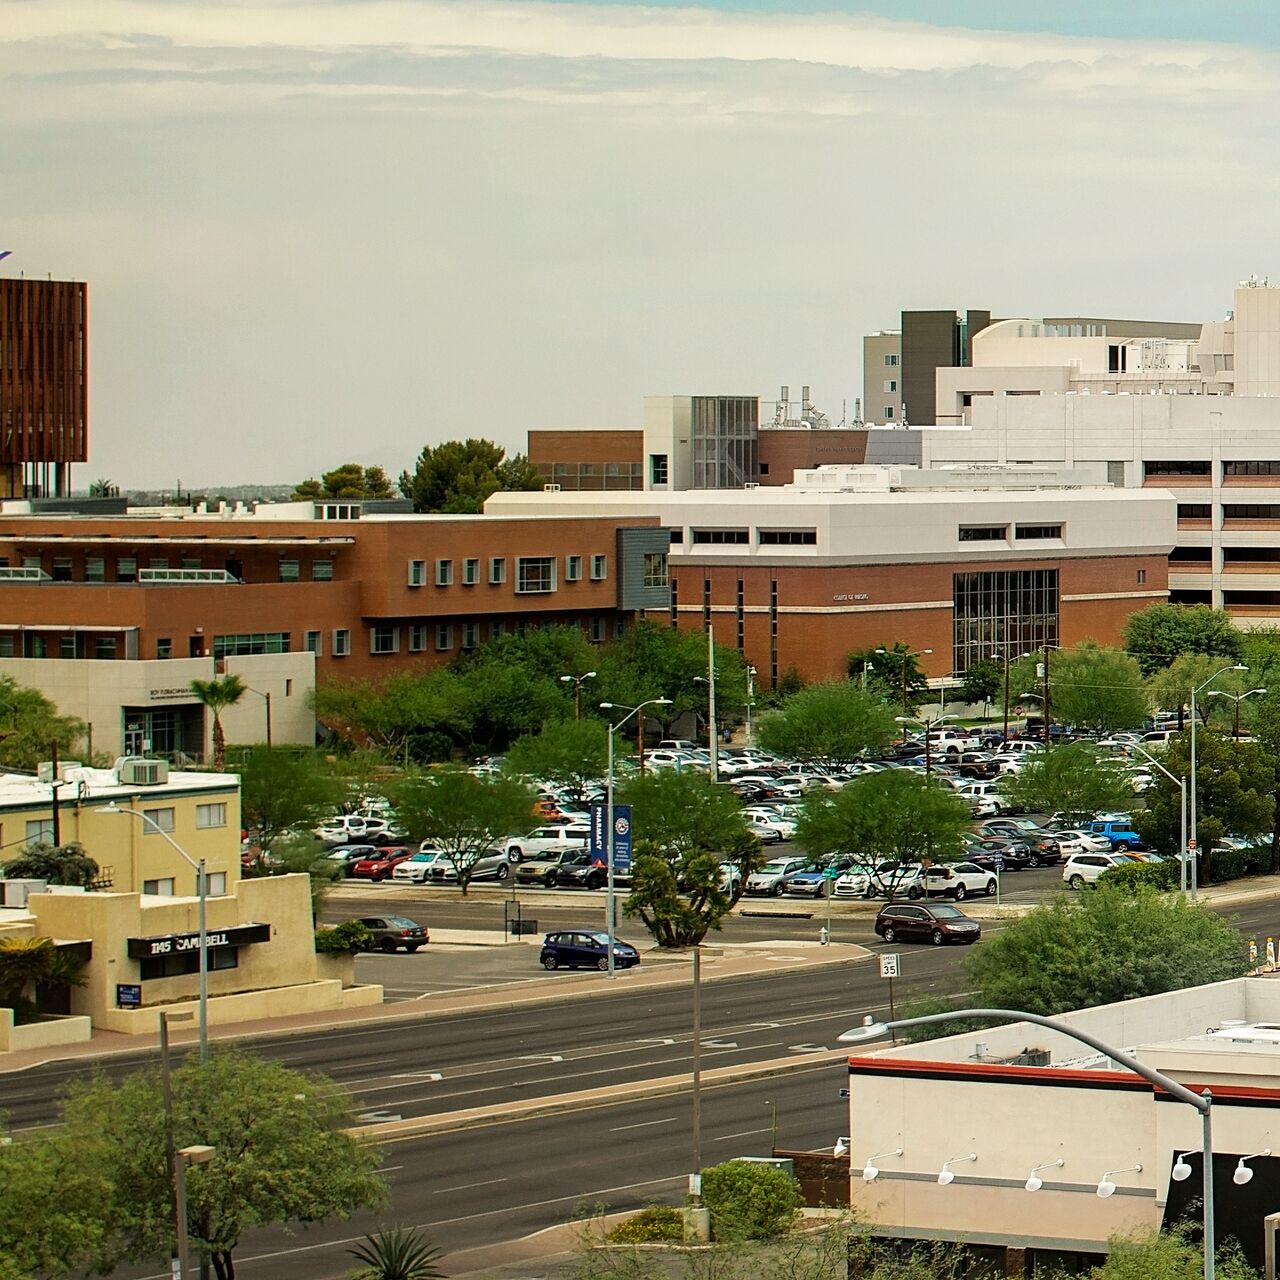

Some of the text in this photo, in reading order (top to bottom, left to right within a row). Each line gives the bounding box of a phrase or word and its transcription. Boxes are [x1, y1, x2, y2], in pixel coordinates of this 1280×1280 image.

[151, 933, 229, 954] 1145 CAMBELL
[883, 965, 896, 975] 35
